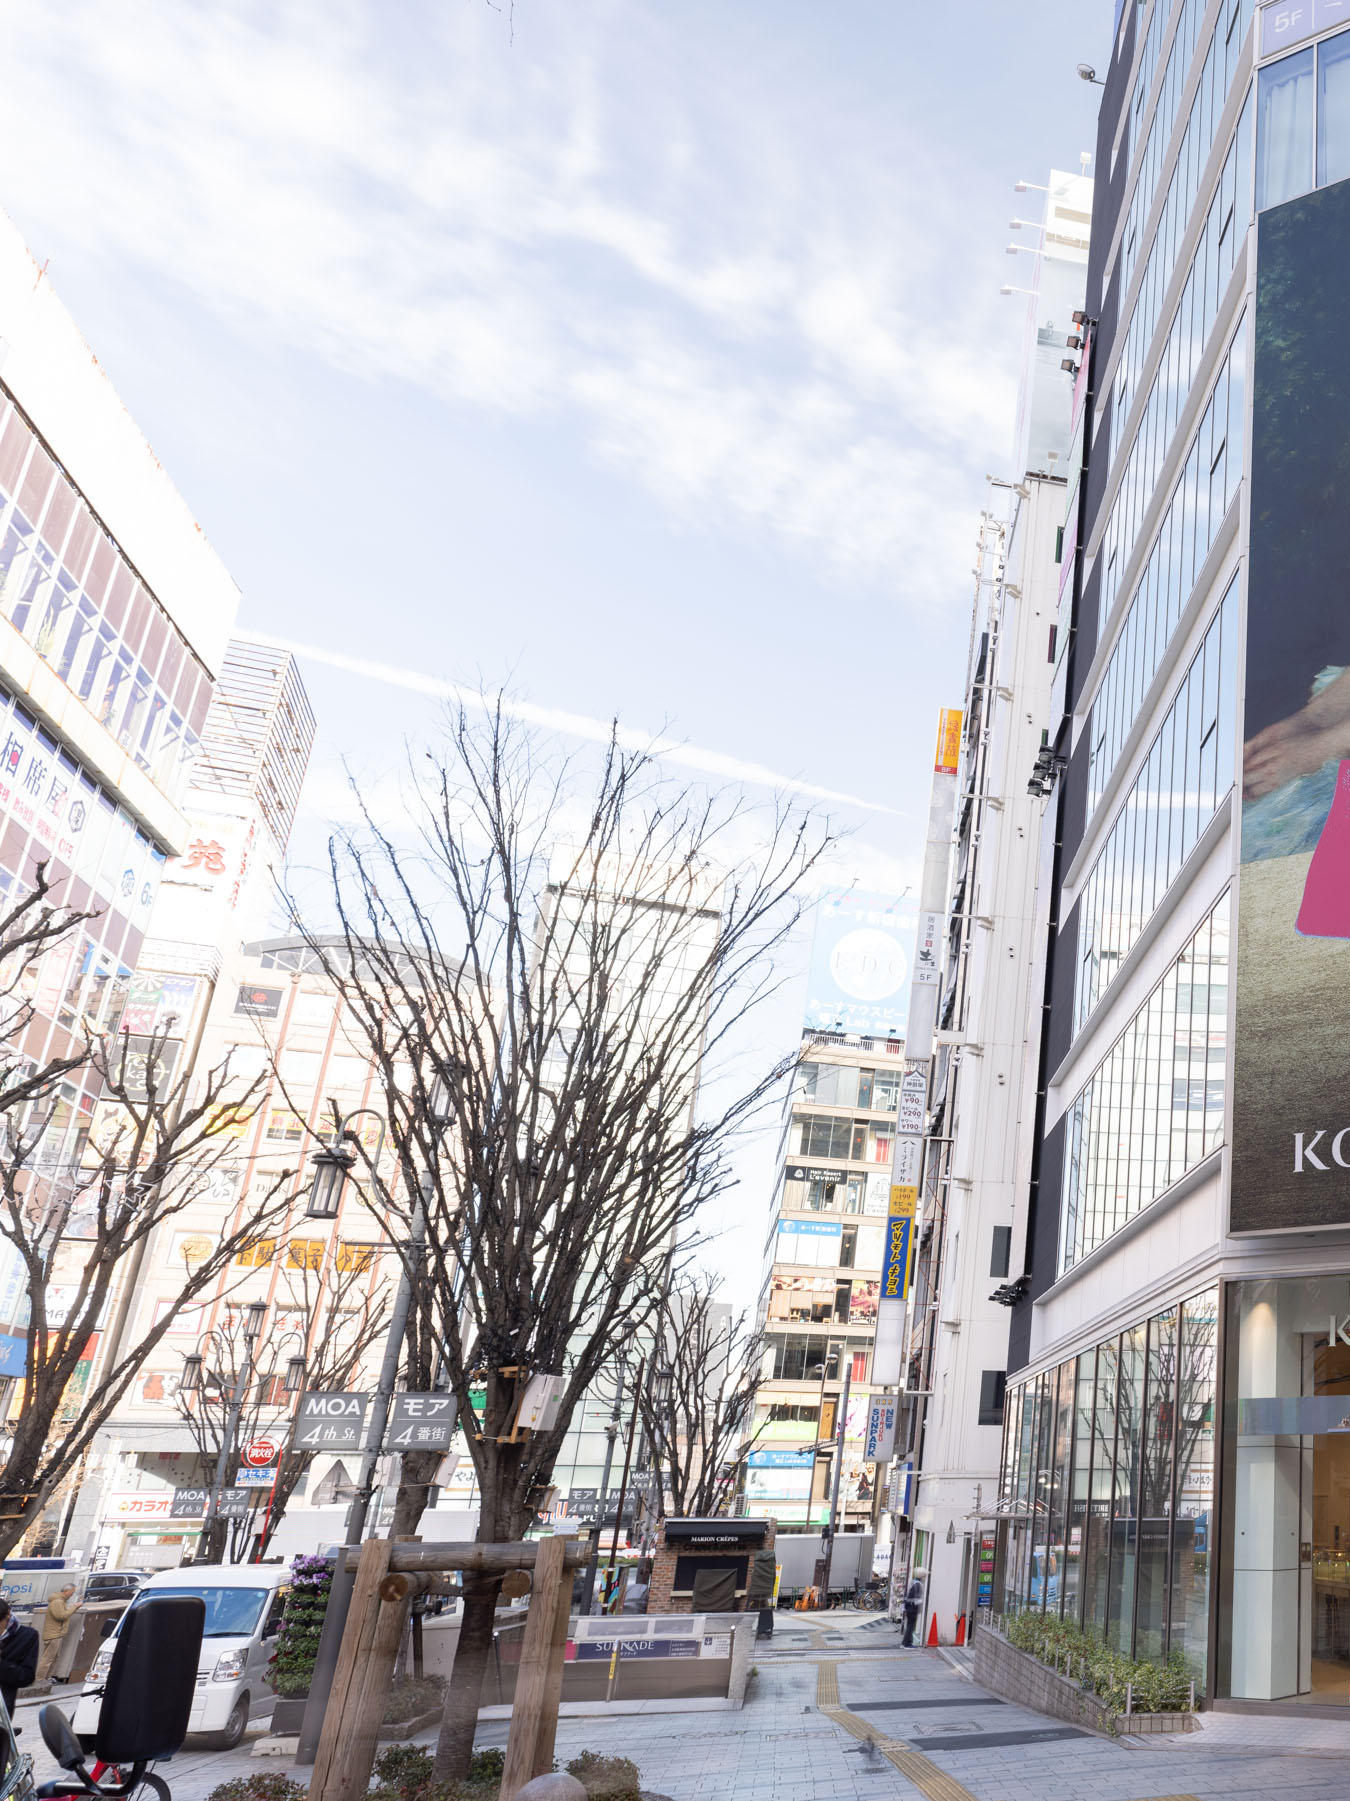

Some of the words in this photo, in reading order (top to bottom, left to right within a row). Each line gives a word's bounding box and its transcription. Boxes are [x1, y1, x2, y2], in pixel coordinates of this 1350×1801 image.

[1274, 9, 1304, 33] 5F
[886, 1220, 906, 1296] マツモトキヨシ
[305, 1398, 361, 1415] MOA
[403, 1399, 450, 1416] モア
[885, 1408, 894, 1430] NEW
[301, 1424, 337, 1445] 4th
[341, 1427, 356, 1440] St.
[393, 1424, 447, 1446] 4番街
[867, 1408, 880, 1457] SUNPARK
[175, 1491, 205, 1500] MOA
[225, 1490, 247, 1500] モア
[571, 1490, 594, 1500] モア
[129, 1500, 173, 1512] カラオ
